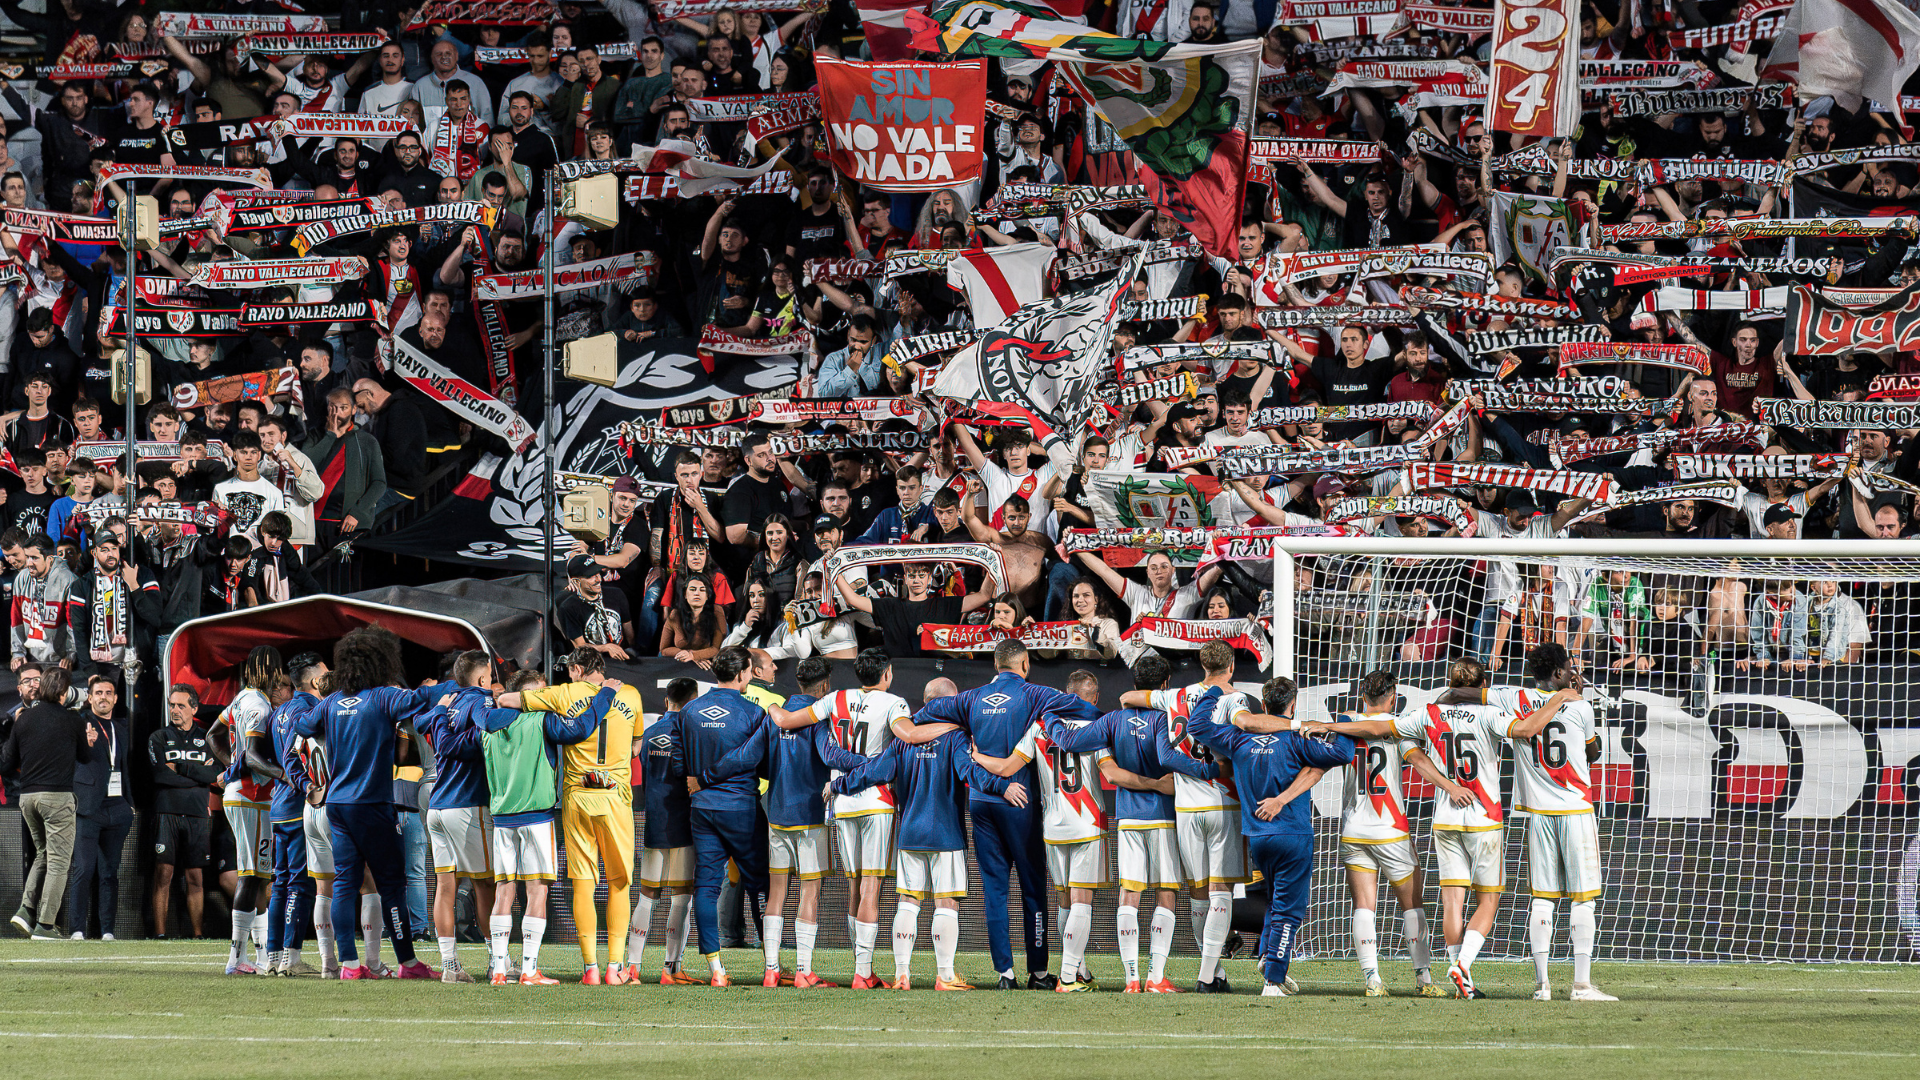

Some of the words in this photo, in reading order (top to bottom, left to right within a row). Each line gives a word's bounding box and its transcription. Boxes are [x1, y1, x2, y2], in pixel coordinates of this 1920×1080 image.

[1294, 3, 1326, 17] RAYO
[1328, 0, 1397, 16] VALLECANO
[212, 19, 286, 32] VALLECANO
[251, 36, 289, 49] RAYO
[293, 34, 379, 49] VALLECANO
[1357, 64, 1386, 79] RAYO
[1387, 62, 1449, 79] VALLECANO
[870, 69, 931, 97] SIN
[1433, 83, 1461, 96] RAYO
[296, 117, 370, 132] VALLECANO
[831, 123, 879, 152] NO
[886, 125, 975, 154] VALE
[855, 152, 955, 182] NADA
[624, 175, 649, 201] EL
[239, 207, 274, 227] Rayo
[423, 202, 484, 221] DONDE
[1301, 255, 1336, 268] RAYO
[222, 267, 255, 281] RAYO
[258, 264, 331, 279] VALLECANO
[510, 264, 605, 294] FACAO
[1294, 269, 1318, 281] 1924
[1623, 272, 1666, 284] CONTIGO
[1667, 267, 1709, 280] SIEMPRE
[248, 307, 285, 321] RAYO
[288, 303, 366, 320] VALLECANO
[481, 302, 509, 377] VALLECANO
[703, 328, 735, 343] RAYO
[737, 331, 811, 347] VALLECANO
[394, 347, 428, 379] RAYO
[428, 374, 508, 426] VALLECANO
[671, 407, 705, 425] Rayo
[1322, 445, 1422, 468] ULTRAS
[1411, 461, 1446, 490] EL
[951, 631, 984, 643] RAYO
[1154, 620, 1183, 639] RAYO
[1186, 619, 1241, 639] VALLECANO
[337, 708, 358, 716] umbro
[566, 694, 635, 721] DIMITVSKI
[983, 707, 1006, 715] umbro
[1440, 709, 1476, 723] CRESPO
[701, 720, 726, 729] umbro
[597, 718, 608, 766] 1
[1530, 720, 1568, 770] 16
[165, 750, 207, 762] DIGI
[1438, 731, 1478, 782] 15
[1045, 745, 1083, 795] 19
[1354, 745, 1388, 796] 12
[390, 906, 404, 940] umbro
[1035, 911, 1043, 948] umbro
[1120, 928, 1137, 937] RVM
[896, 932, 915, 941] RVM
[1276, 923, 1292, 959] umbro
